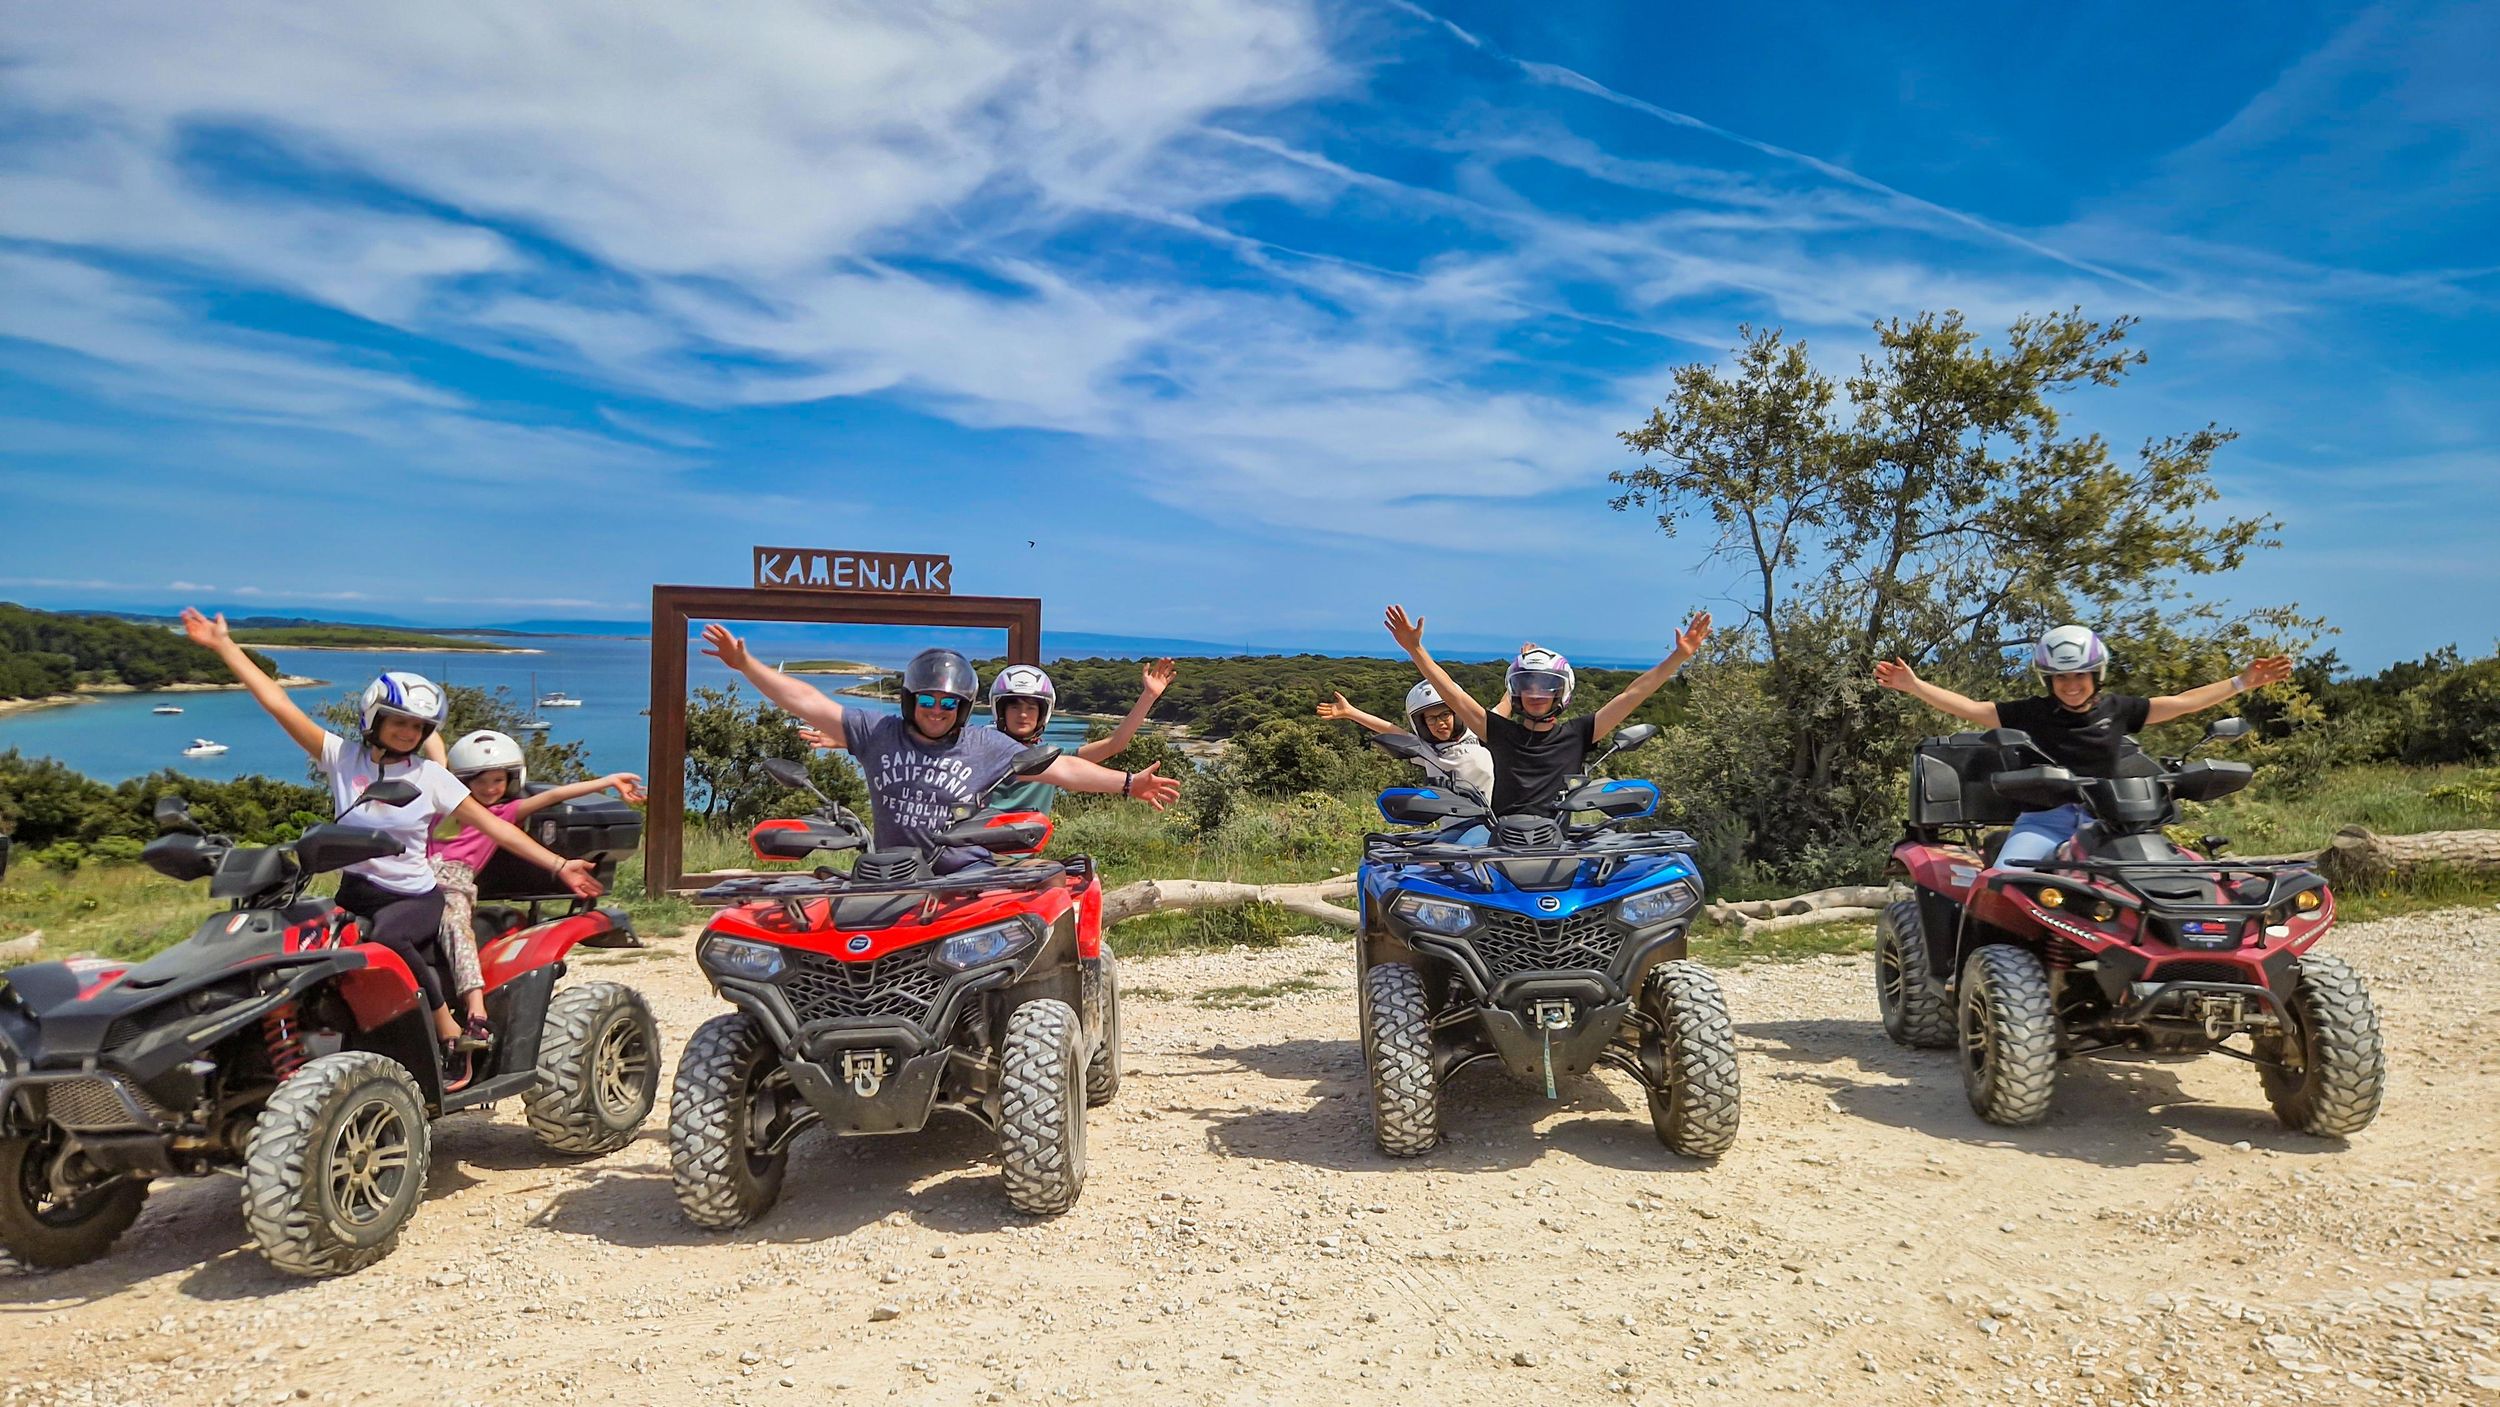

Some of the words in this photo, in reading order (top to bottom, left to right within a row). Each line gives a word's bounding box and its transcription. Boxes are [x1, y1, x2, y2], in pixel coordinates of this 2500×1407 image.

[760, 553, 945, 589] KAMENJAK
[881, 750, 916, 769] SAN
[922, 755, 972, 781] DIEGO
[874, 766, 973, 803] CALIFORNIA
